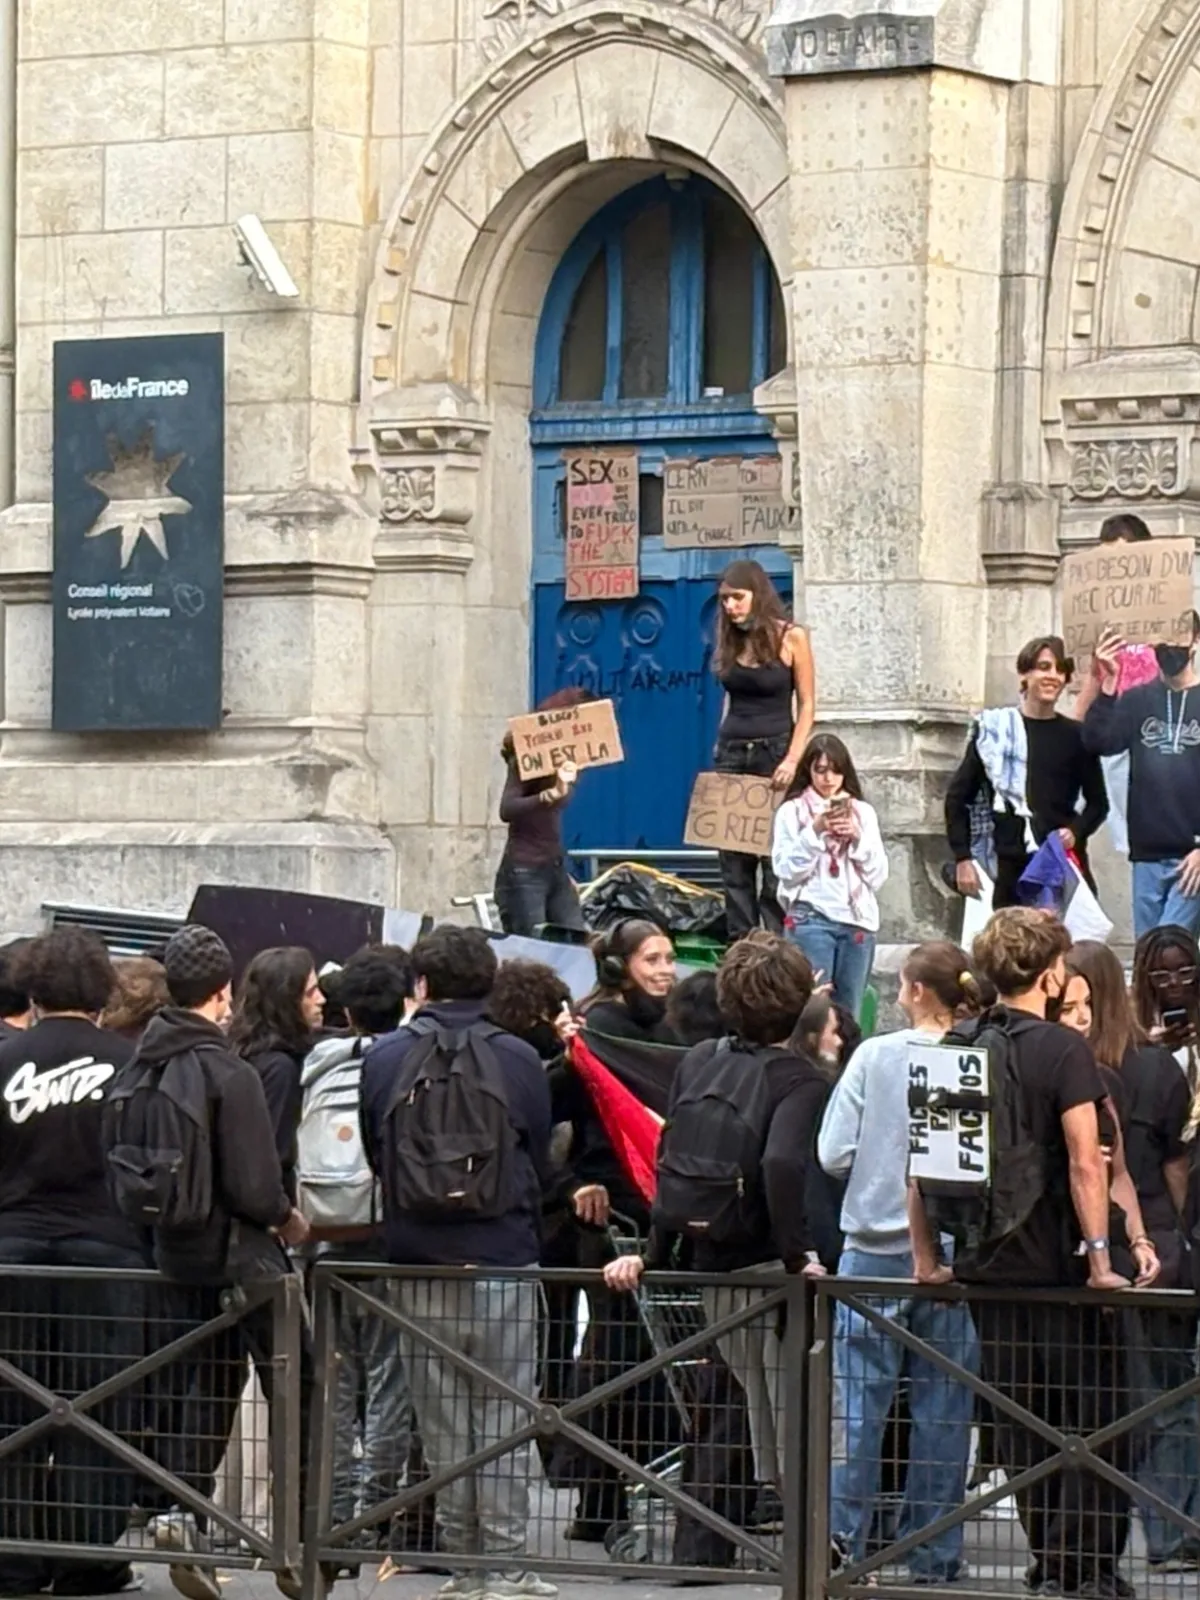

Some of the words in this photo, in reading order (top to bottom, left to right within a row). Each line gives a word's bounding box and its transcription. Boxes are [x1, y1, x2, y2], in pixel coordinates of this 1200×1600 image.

[781, 23, 919, 58] VOLTAIRE
[571, 459, 614, 486] SEX
[572, 505, 603, 521] EVER
[742, 506, 786, 536] FAUX
[570, 525, 583, 538] TO
[584, 523, 635, 544] FUCK
[569, 541, 604, 562] THE
[569, 568, 635, 596] SYSTEM
[1072, 587, 1099, 616] MEC
[1105, 584, 1143, 610] POUR
[1148, 581, 1168, 606] ME
[521, 752, 543, 773] ON
[549, 744, 577, 768] EST
